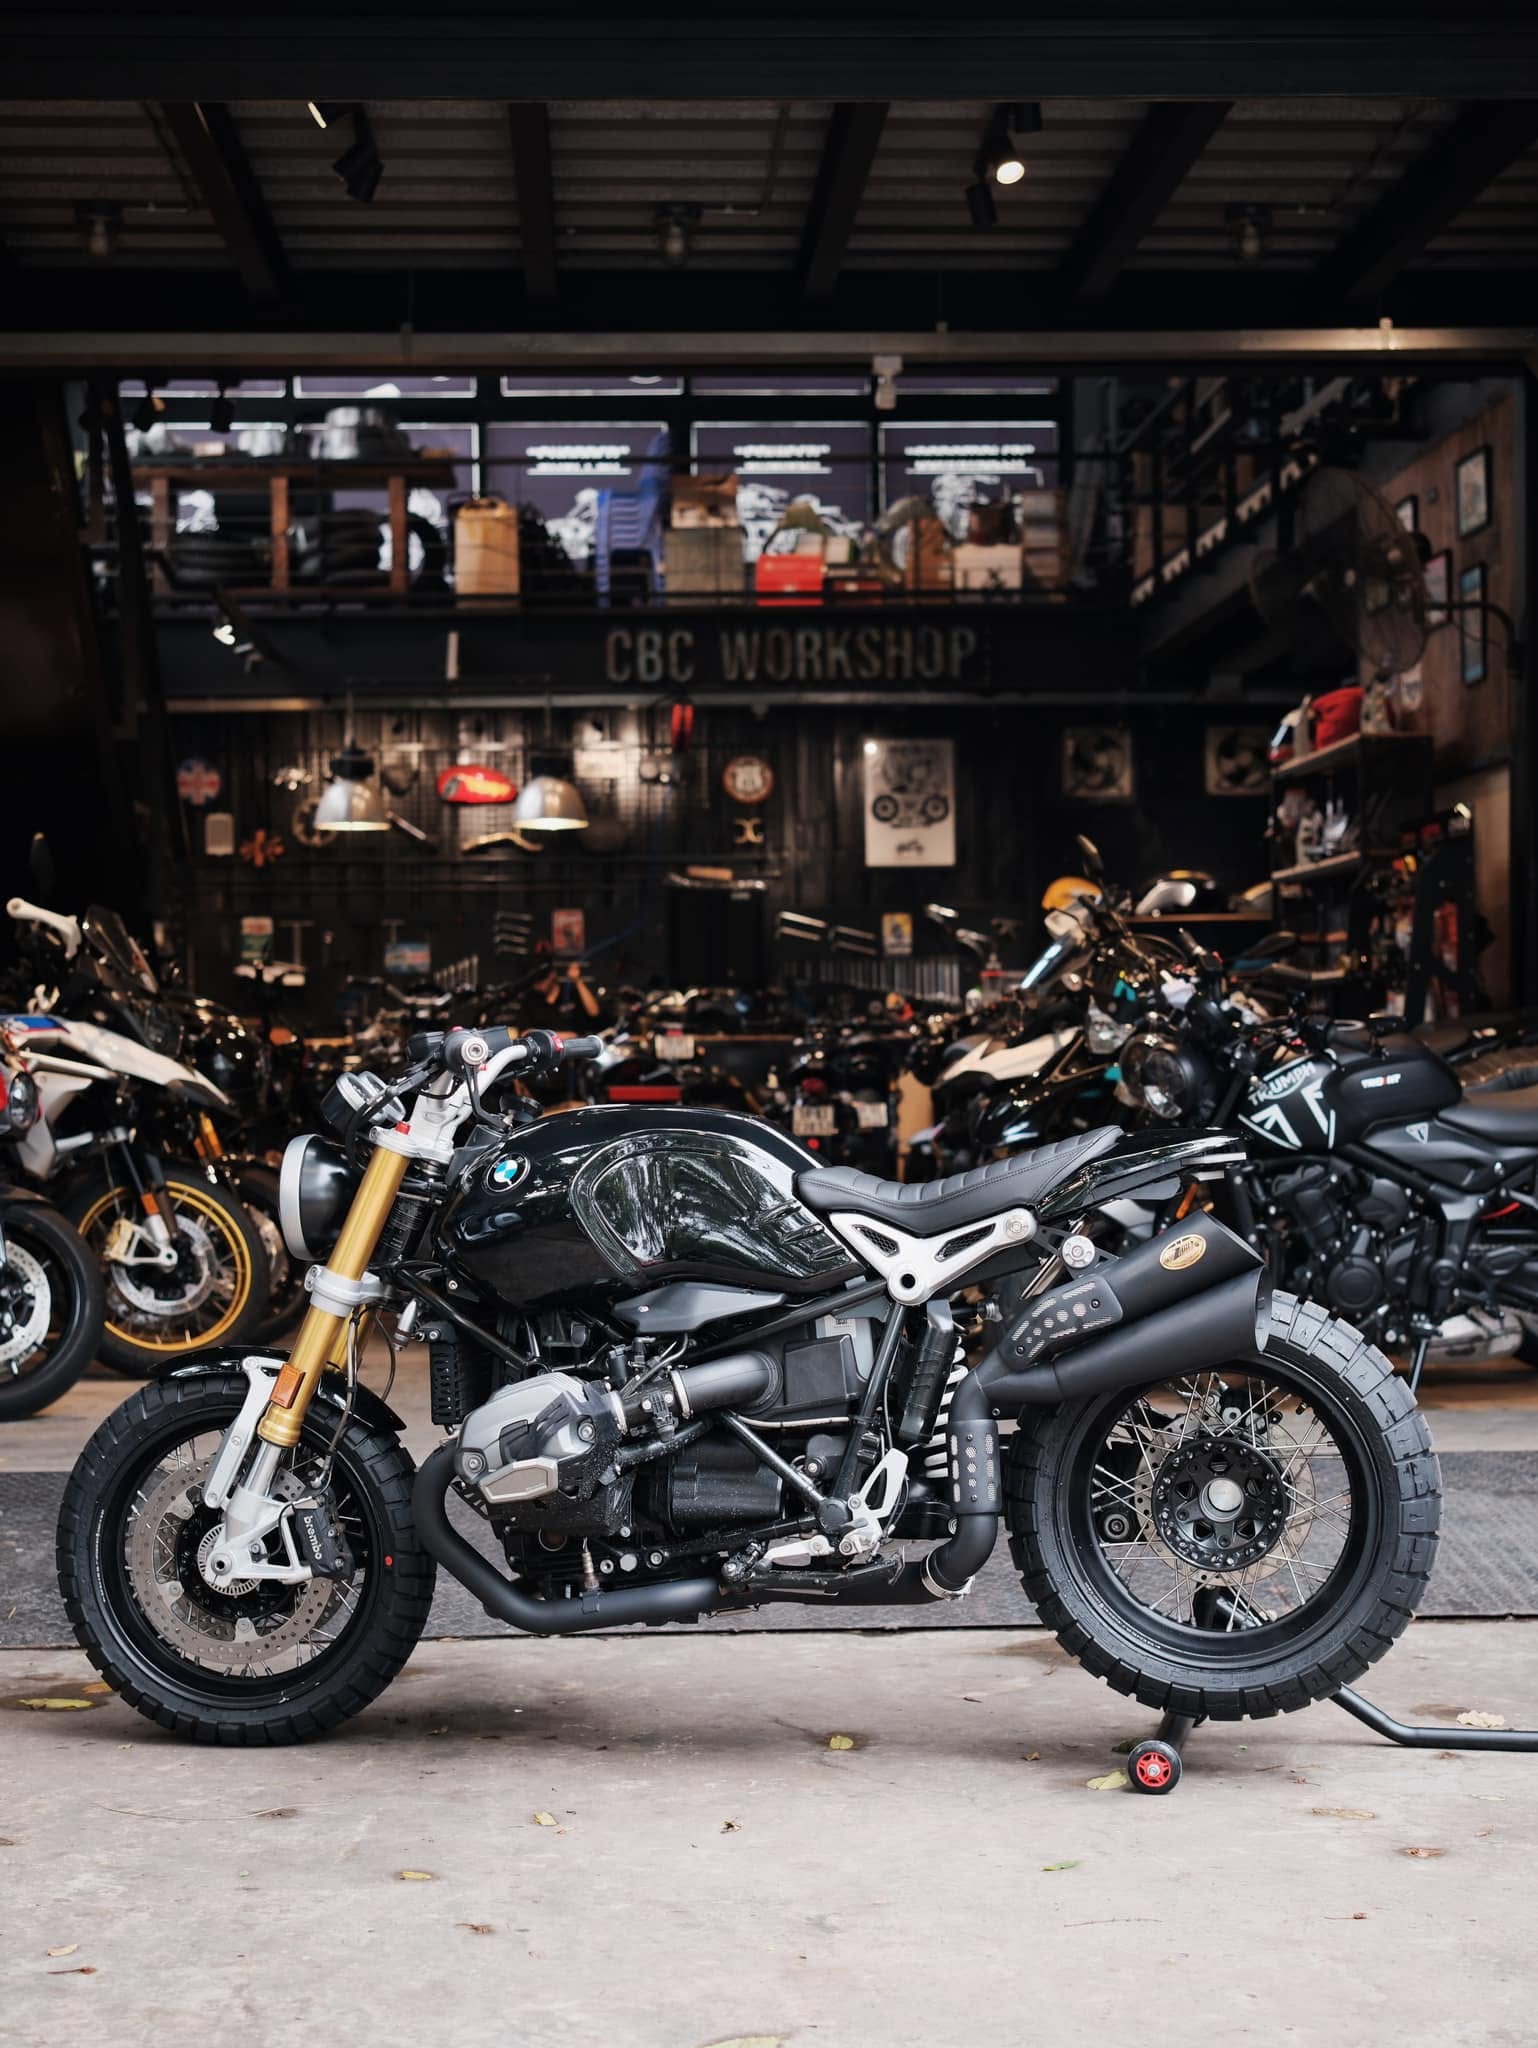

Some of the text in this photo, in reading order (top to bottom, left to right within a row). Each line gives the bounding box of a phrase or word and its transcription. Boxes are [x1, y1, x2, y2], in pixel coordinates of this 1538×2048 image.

[605, 629, 695, 682] CBC
[720, 626, 976, 682] WORKSHOP
[303, 1515, 322, 1560] brembo
